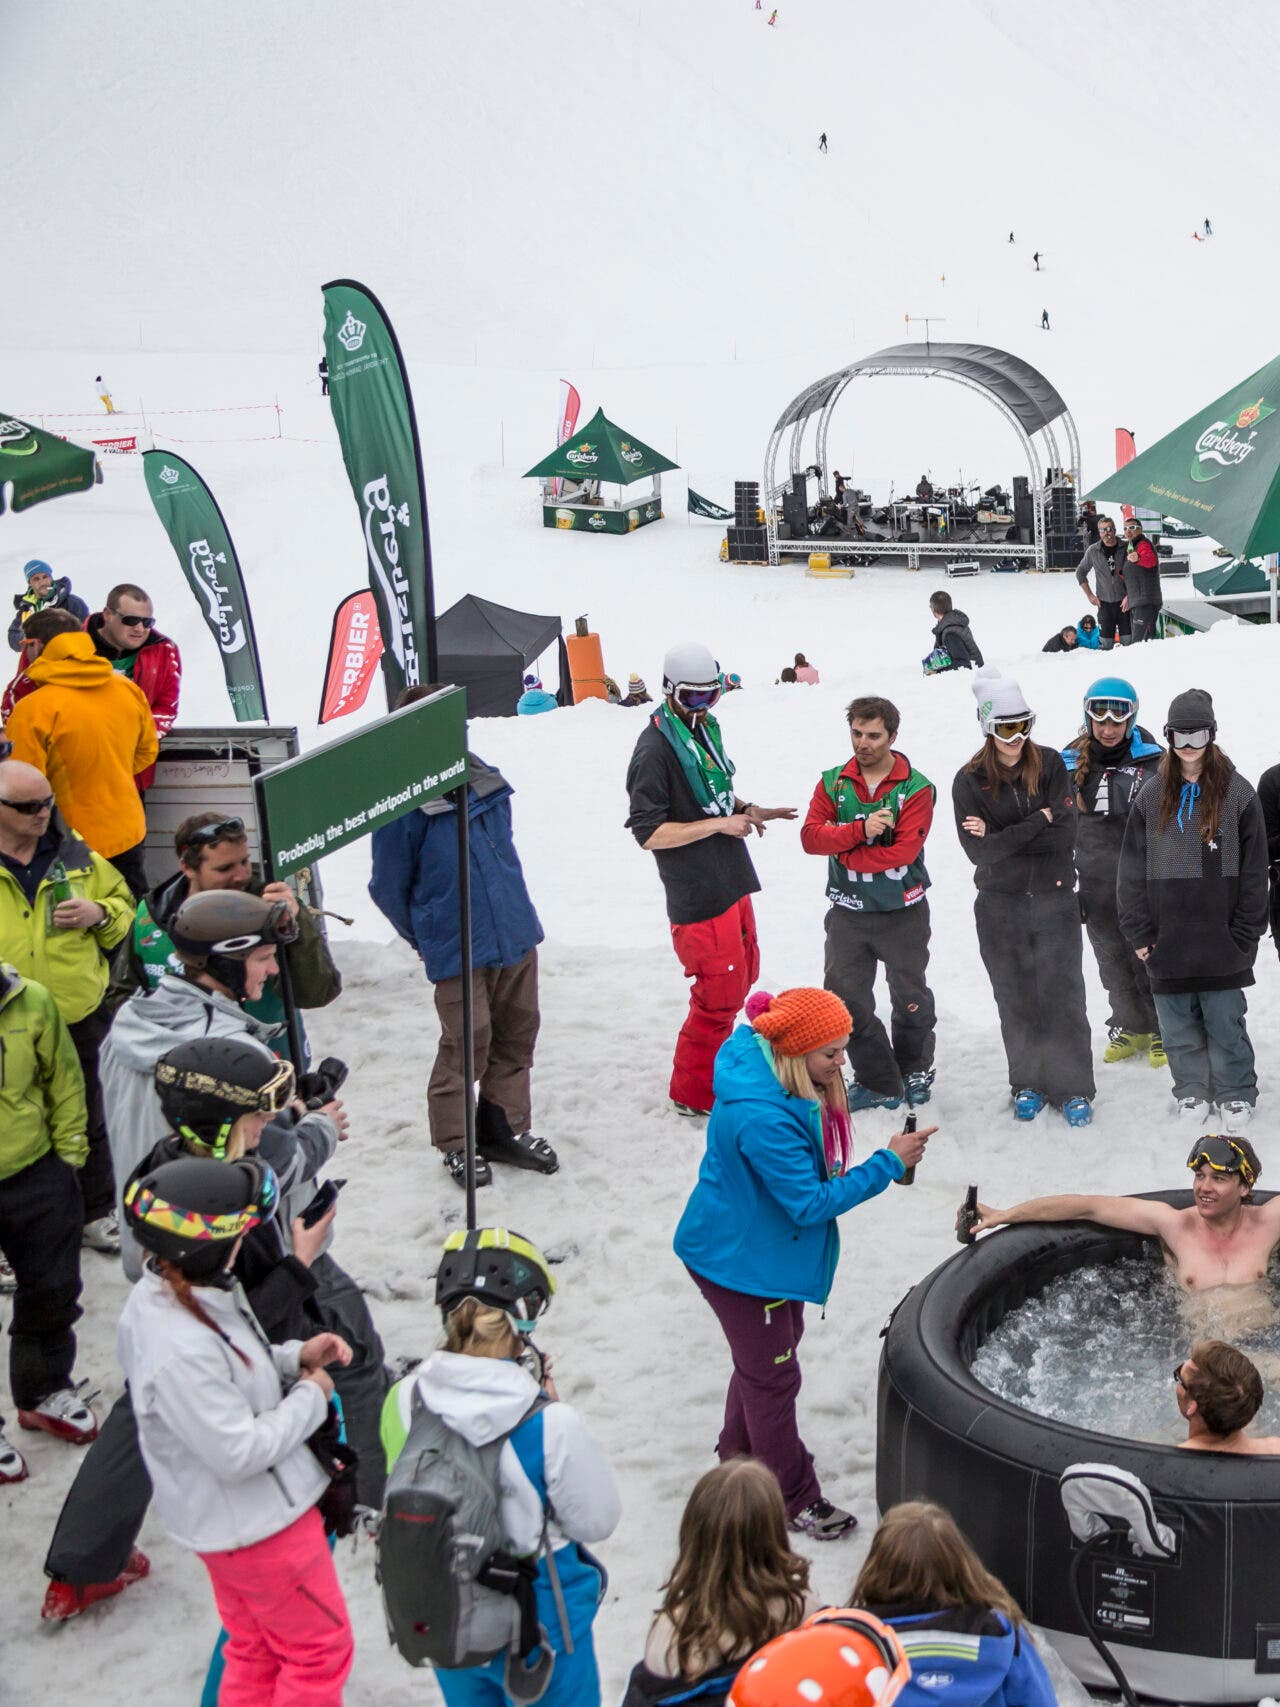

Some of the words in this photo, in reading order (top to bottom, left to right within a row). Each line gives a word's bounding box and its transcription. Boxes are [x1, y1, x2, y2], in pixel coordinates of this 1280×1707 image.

[1195, 421, 1256, 467] Carlsberg
[277, 833, 325, 867] Probably
[326, 825, 343, 841] the
[344, 811, 367, 834] best
[367, 789, 412, 819] whirlpool
[412, 783, 422, 796] in
[423, 775, 438, 791] the
[440, 758, 465, 781] world
